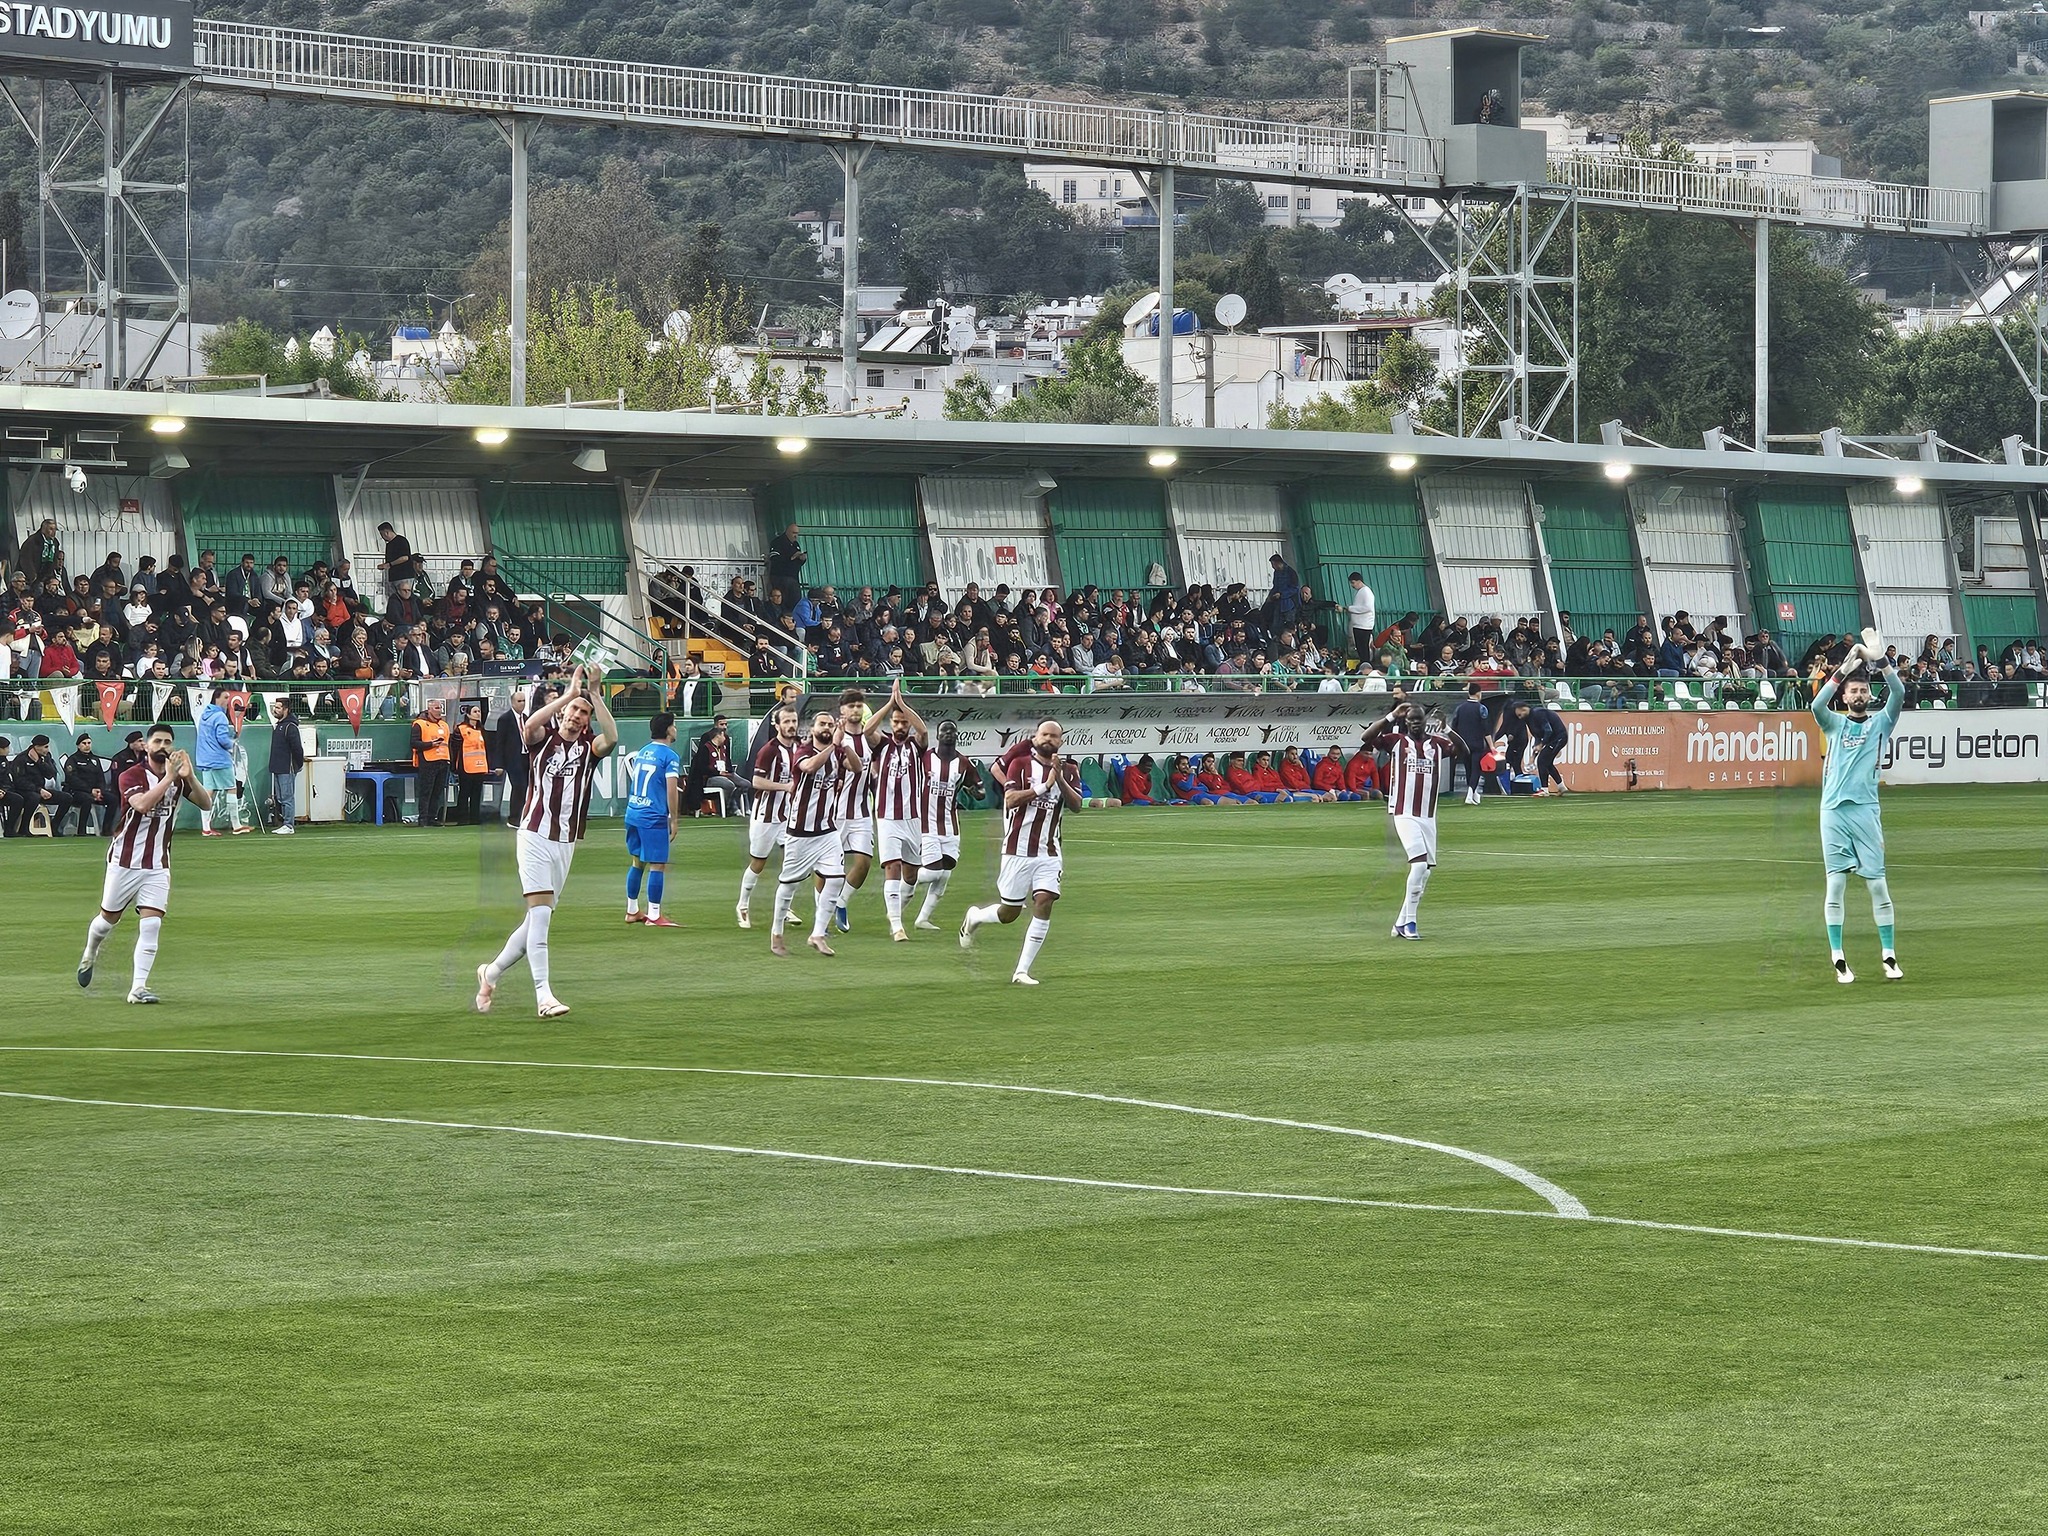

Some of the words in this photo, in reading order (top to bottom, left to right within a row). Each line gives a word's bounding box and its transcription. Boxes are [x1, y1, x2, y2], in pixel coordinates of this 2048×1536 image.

[0, 2, 171, 49] STADYUMU
[1101, 727, 1148, 739] ACROPOL
[1206, 726, 1251, 738] ACROPOL
[1309, 724, 1353, 735] ACROPOL
[1168, 732, 1200, 744] AURA
[1270, 731, 1300, 743] AURA
[1687, 718, 1808, 763] mandalin
[1956, 727, 2039, 759] beton
[328, 740, 372, 750] BODRUMSPOR
[632, 762, 657, 797] 17
